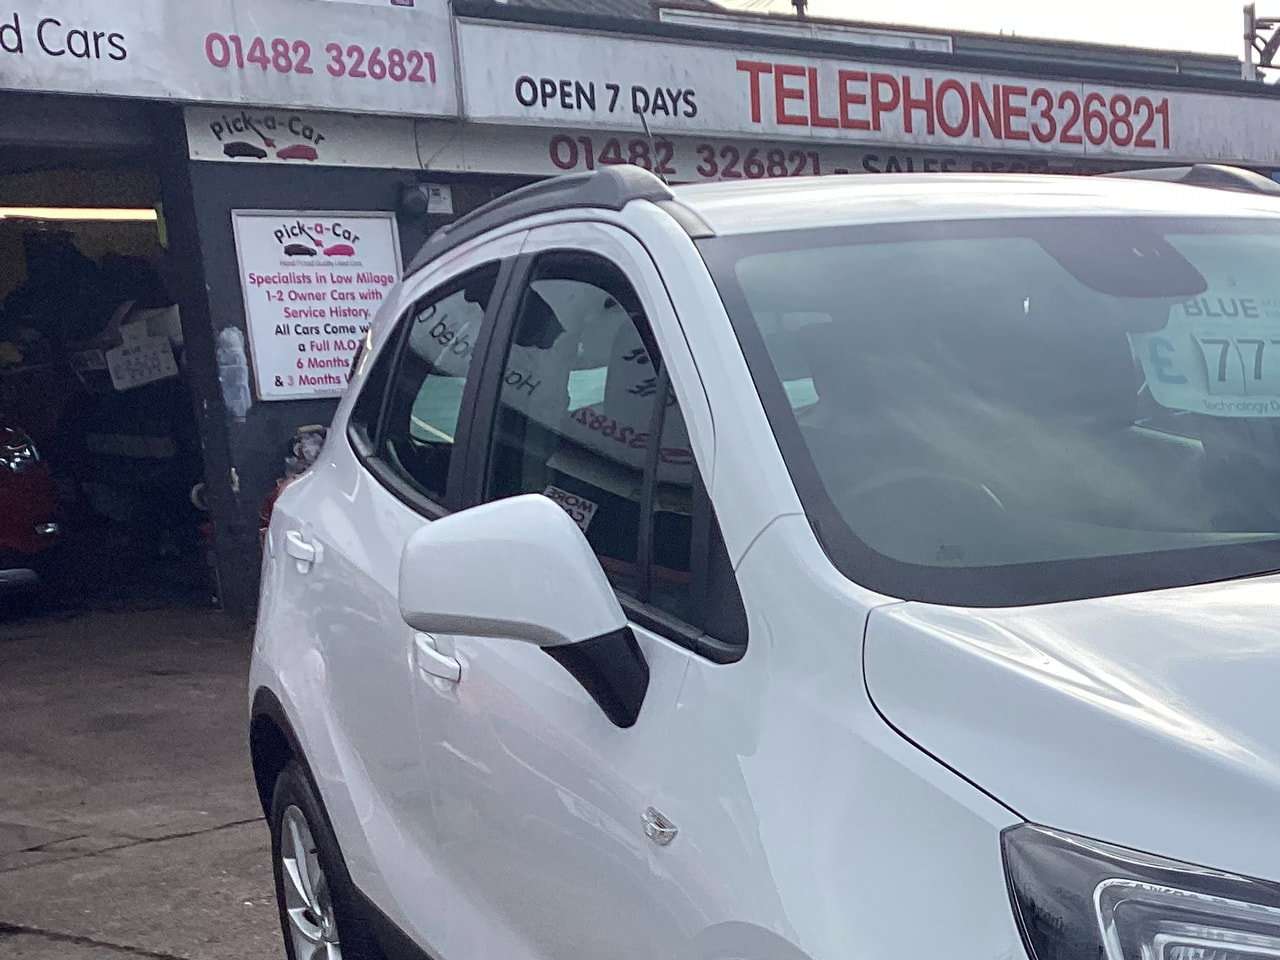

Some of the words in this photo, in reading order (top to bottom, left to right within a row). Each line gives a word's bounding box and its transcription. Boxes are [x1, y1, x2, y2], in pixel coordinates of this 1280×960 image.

[37, 18, 127, 61] Cars
[205, 32, 314, 74] 01482
[325, 42, 437, 84] 326821
[515, 75, 596, 111] OPEN
[605, 83, 620, 112] 7
[631, 86, 698, 118] DAYS
[549, 133, 677, 176] 01482
[696, 141, 821, 178] 326821
[249, 272, 312, 286] Specialists
[316, 273, 326, 283] in
[331, 273, 352, 284] Low
[356, 272, 394, 286] Milage
[266, 290, 284, 301] 1-2
[288, 290, 326, 301] Owner
[330, 289, 355, 300] Cars
[359, 288, 383, 300] with
[284, 306, 326, 318] Service
[1183, 298, 1260, 318] BLUE
[275, 324, 291, 336] All
[294, 324, 320, 335] Cars
[324, 323, 356, 335] Come
[298, 343, 305, 351] a
[310, 340, 330, 351] Full
[297, 358, 304, 369] 6
[308, 357, 350, 368] Months
[275, 375, 284, 387] &
[299, 374, 341, 386] Months
